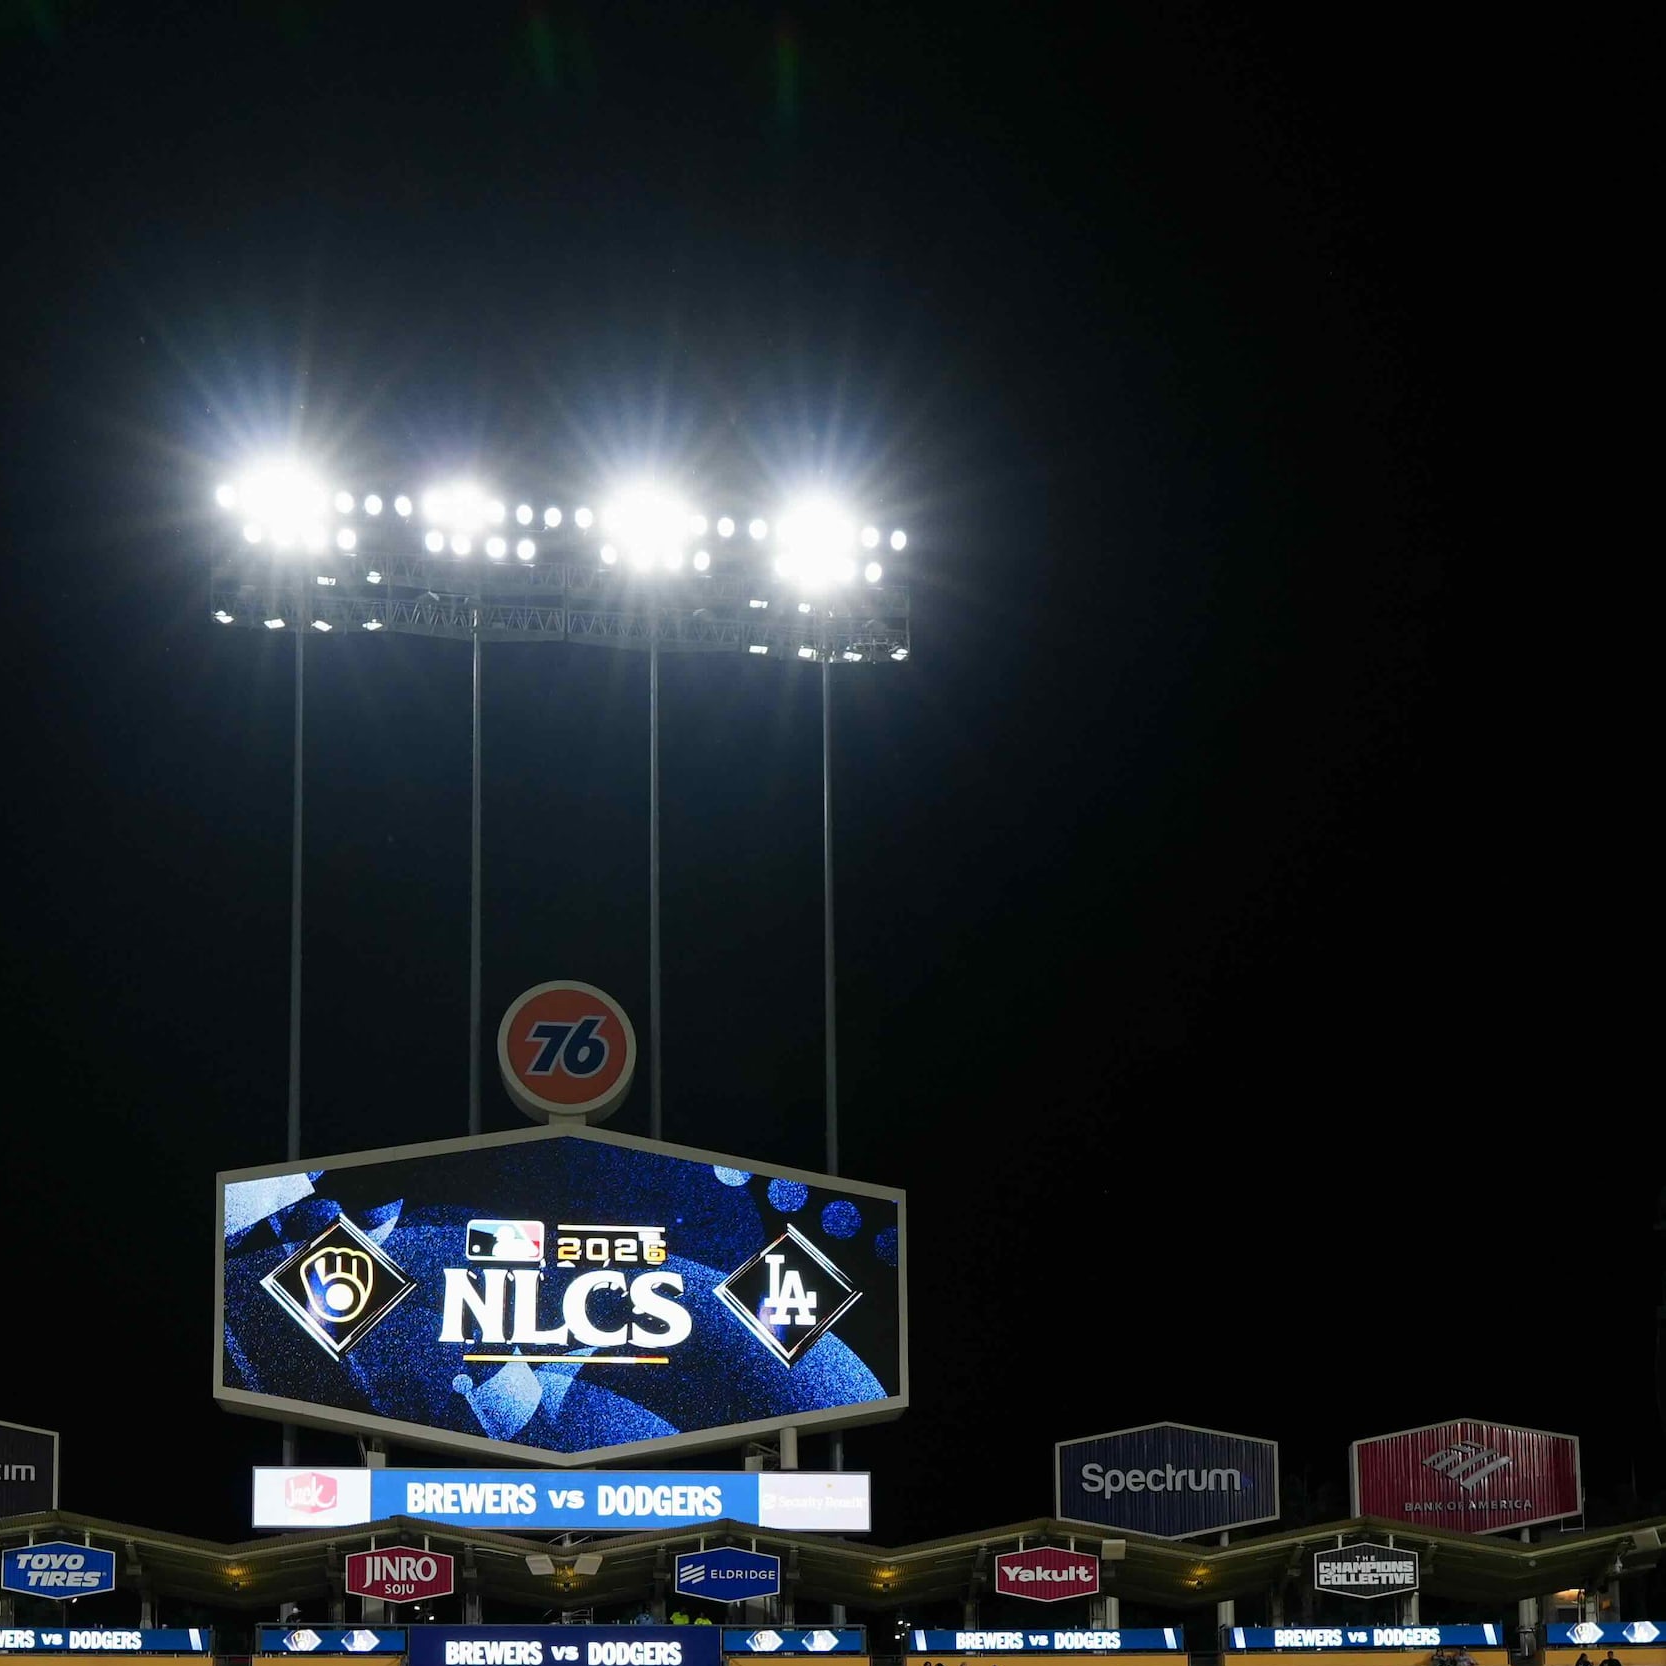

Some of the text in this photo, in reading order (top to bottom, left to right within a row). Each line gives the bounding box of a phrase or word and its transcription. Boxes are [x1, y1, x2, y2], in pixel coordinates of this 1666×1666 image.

[525, 1014, 609, 1078] 76
[557, 1236, 667, 1263] 2026
[762, 1253, 817, 1327] LA
[438, 1267, 694, 1349] NLCS
[1081, 1463, 1243, 1499] Spectrum
[406, 1483, 536, 1515] BREWERS
[597, 1485, 723, 1517] DODGERS
[1404, 1499, 1533, 1512] BANK OF AMERICA
[16, 1553, 85, 1571] TOYO
[363, 1555, 438, 1584] JINRO
[1318, 1561, 1415, 1576] CHAMPIONS
[27, 1570, 101, 1588] TIRES
[710, 1568, 776, 1580] ELDRIDGE
[1000, 1565, 1092, 1584] Yakult
[1318, 1571, 1416, 1587] COLLECTIVE
[384, 1583, 416, 1596] SOJU
[69, 1630, 142, 1650] DODGERS
[955, 1631, 1023, 1651] BREWERS
[1054, 1630, 1121, 1650] DODGERS
[1274, 1628, 1342, 1647] BREWERS
[1373, 1627, 1440, 1646] DODGERS
[445, 1641, 543, 1665] BREWERS
[587, 1641, 682, 1666] DODGERS
